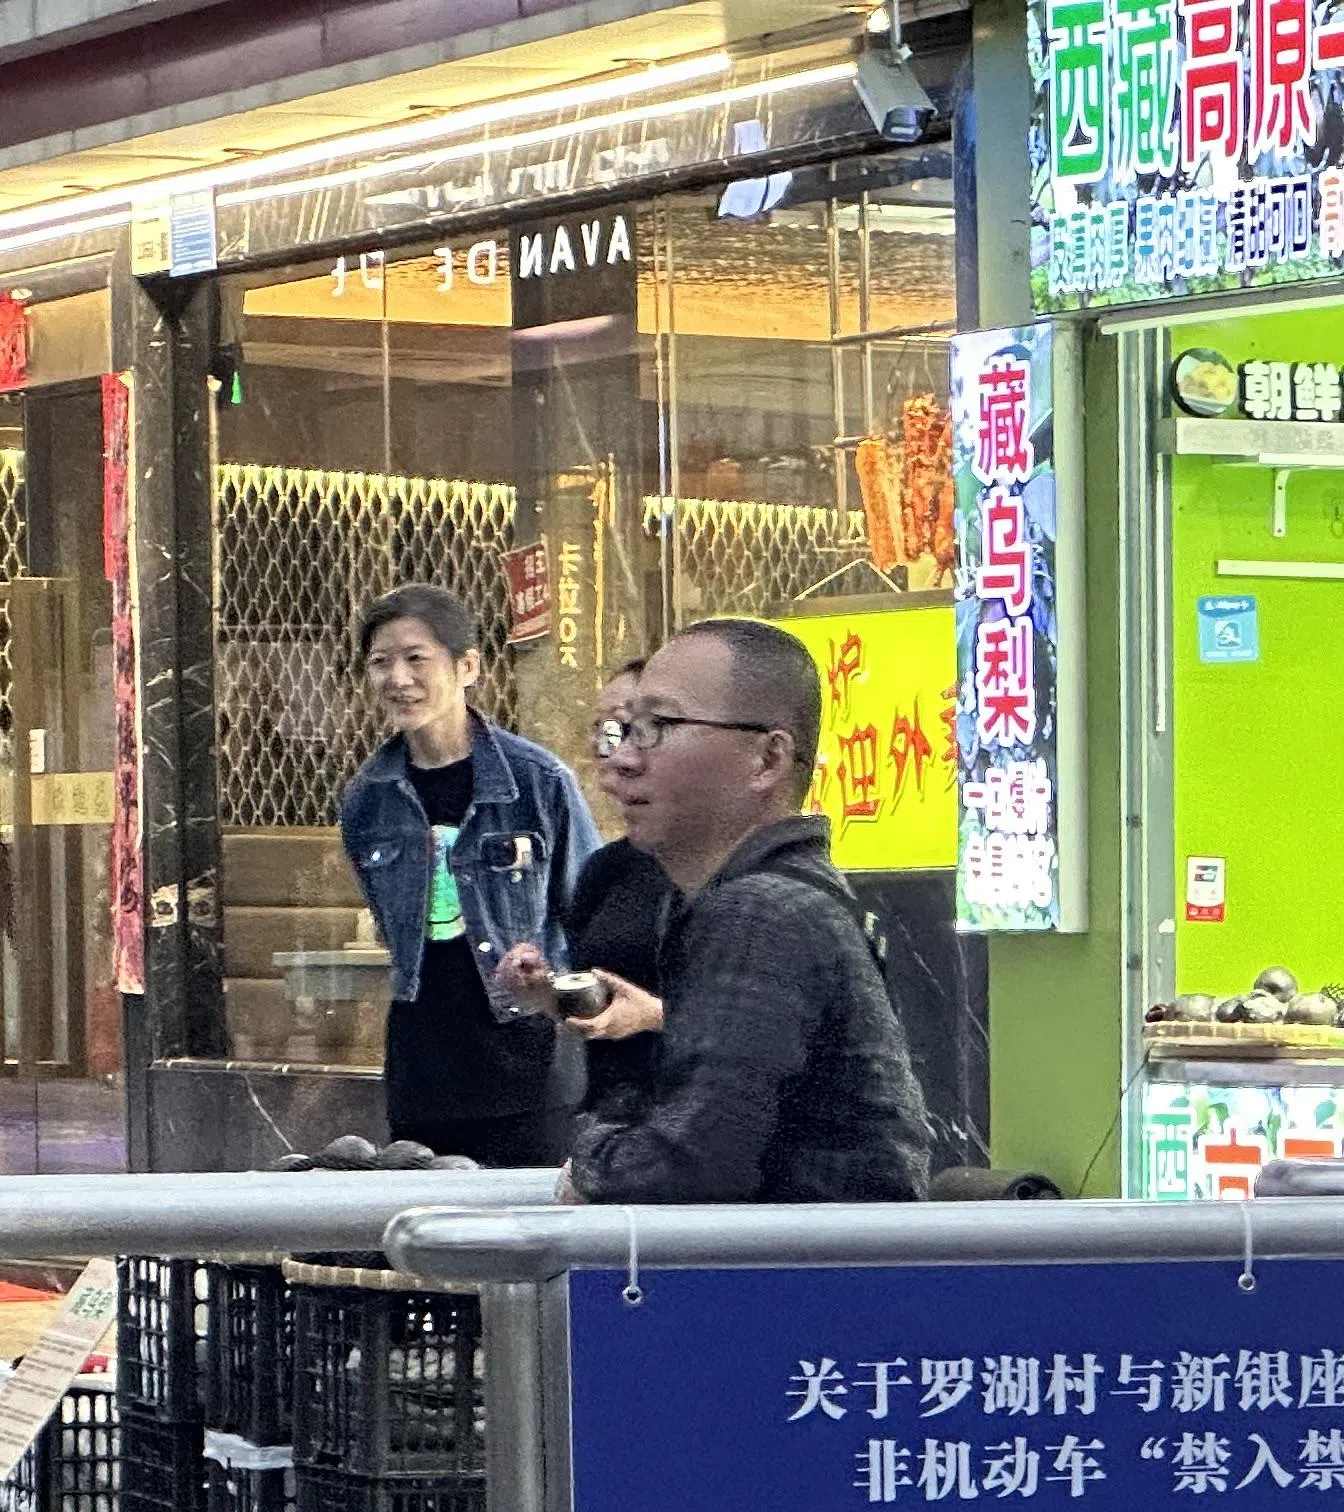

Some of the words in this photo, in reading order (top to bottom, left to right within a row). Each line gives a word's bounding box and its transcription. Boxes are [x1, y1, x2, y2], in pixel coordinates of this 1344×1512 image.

[1228, 174, 1311, 271] 清甜可口
[978, 358, 1033, 742] 藏乌梨
